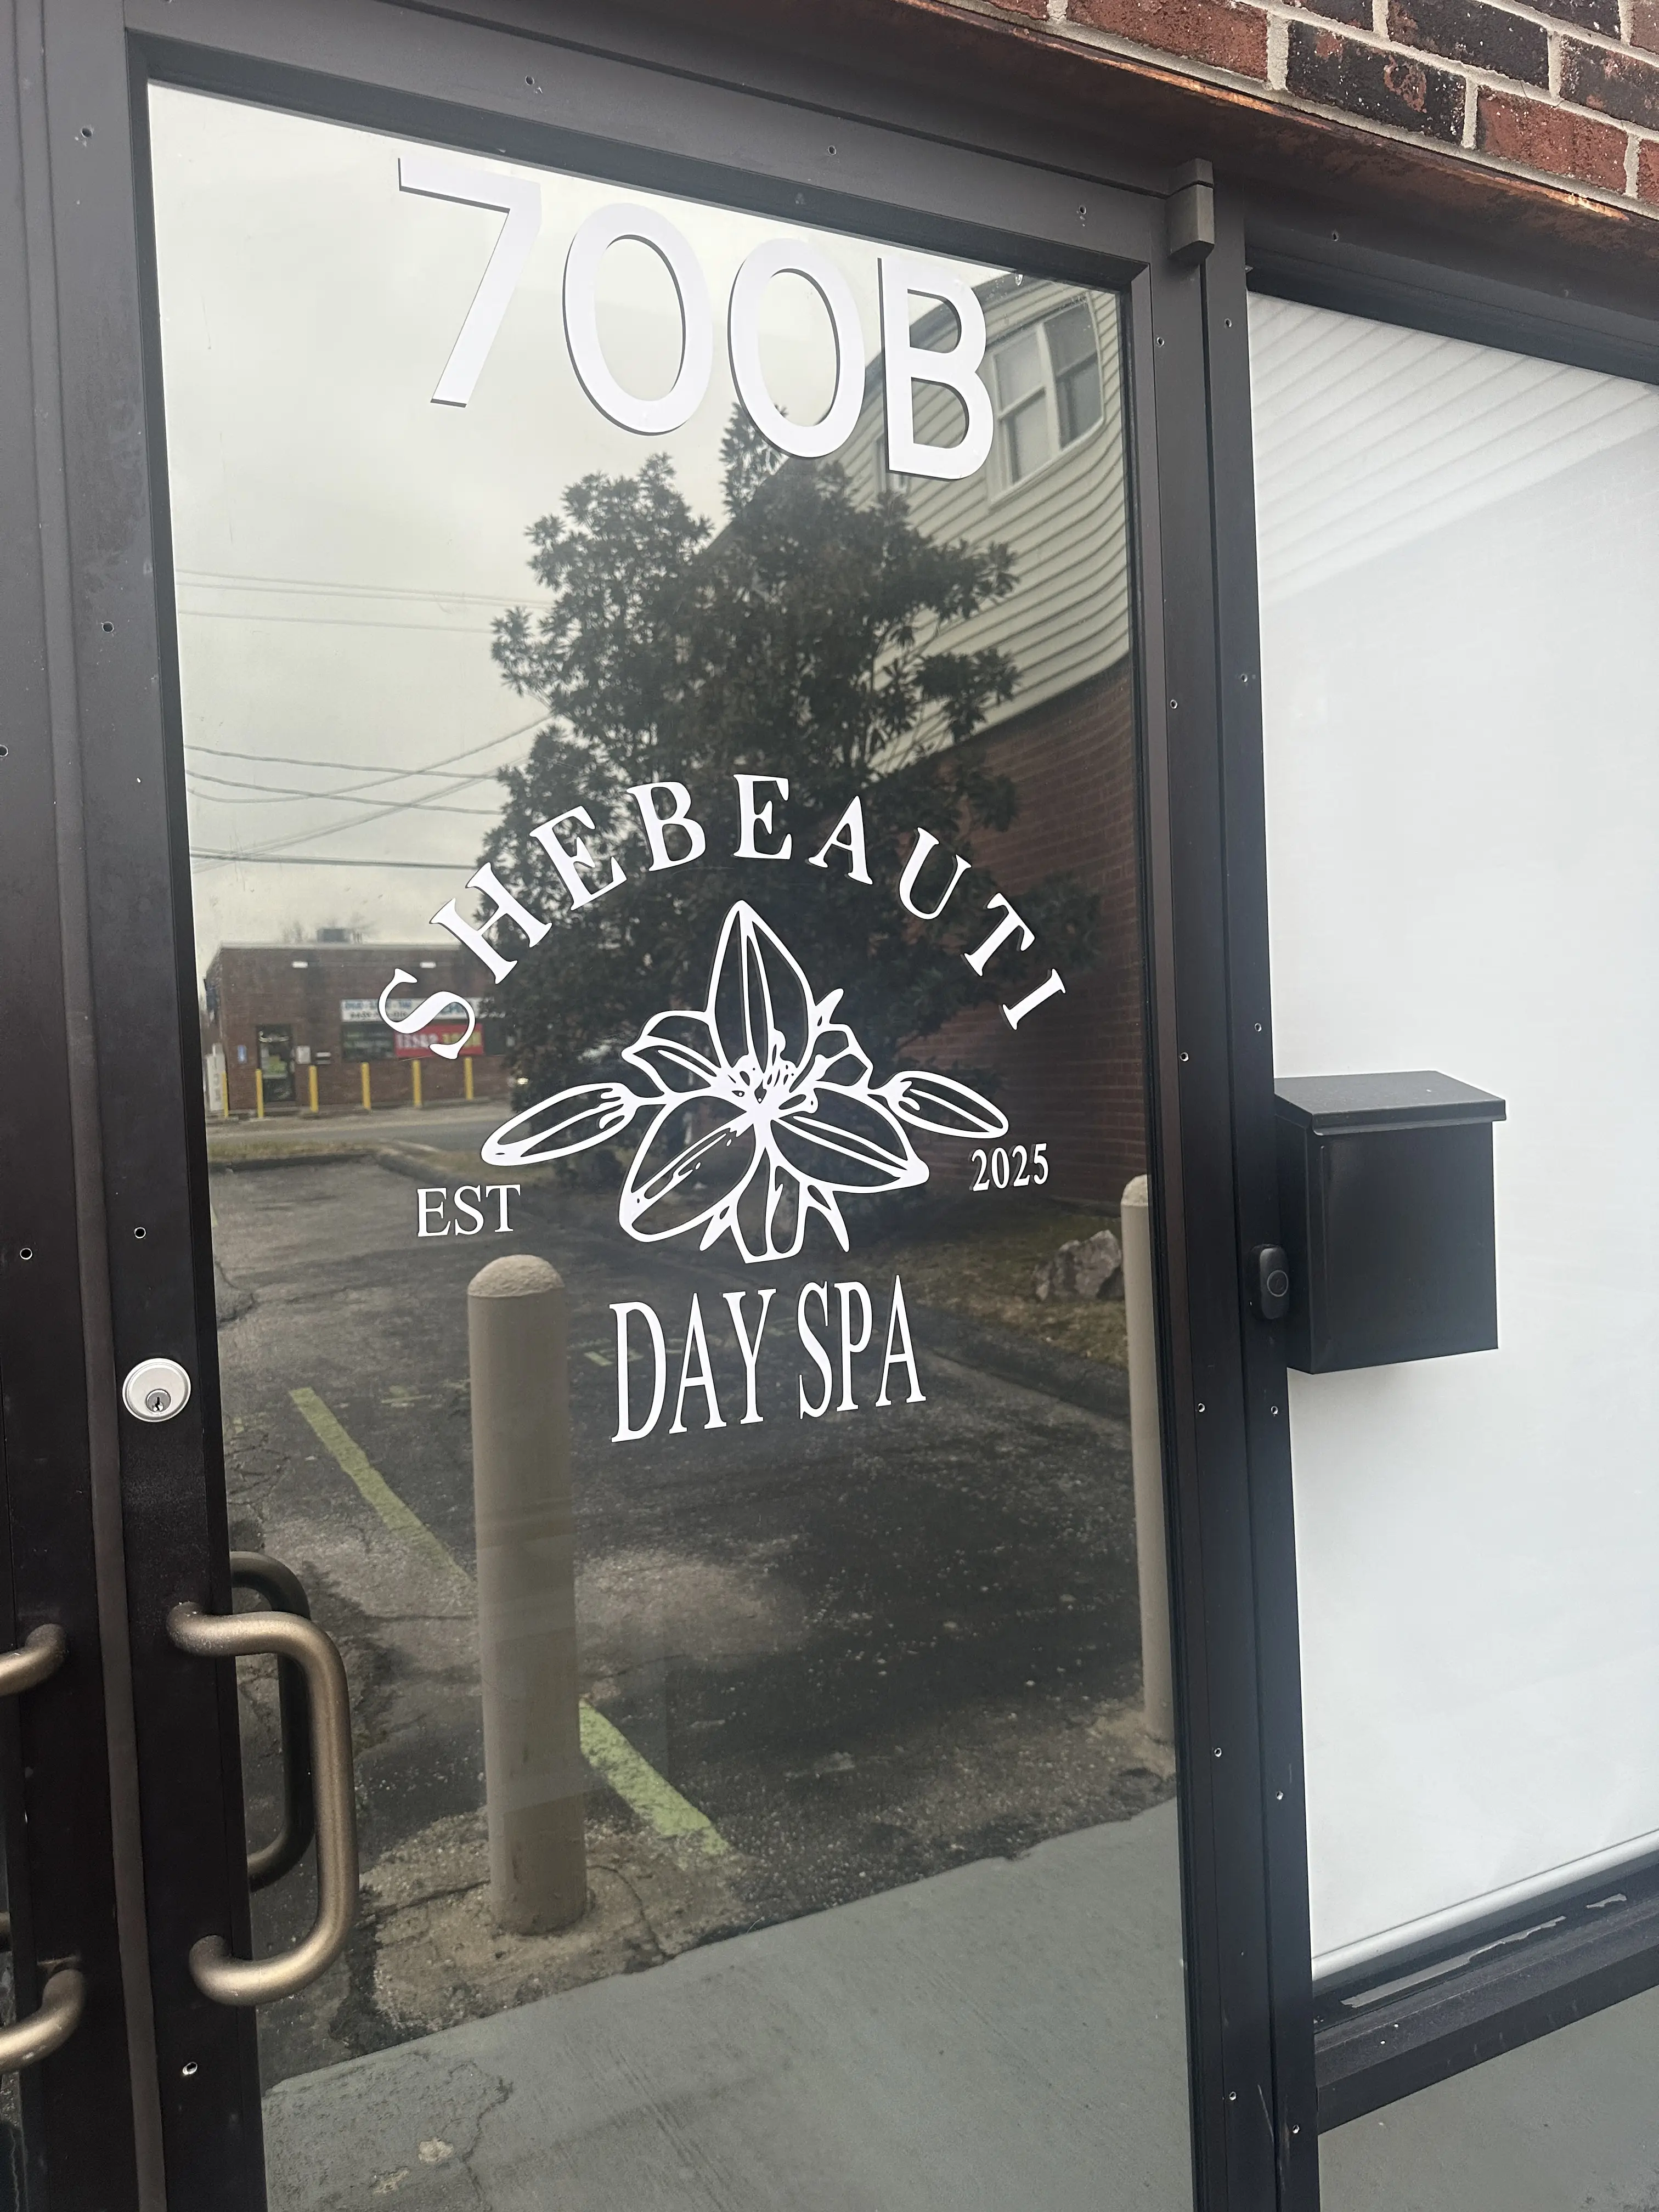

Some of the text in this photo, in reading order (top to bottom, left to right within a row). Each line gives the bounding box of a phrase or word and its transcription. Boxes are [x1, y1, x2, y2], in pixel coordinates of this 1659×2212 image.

[398, 157, 994, 481] 700B
[379, 774, 1066, 1059] SHEBEAUTI
[416, 1183, 521, 1238] EST
[970, 1142, 1049, 1192] 2025
[609, 1274, 927, 1443] DAY SPA
